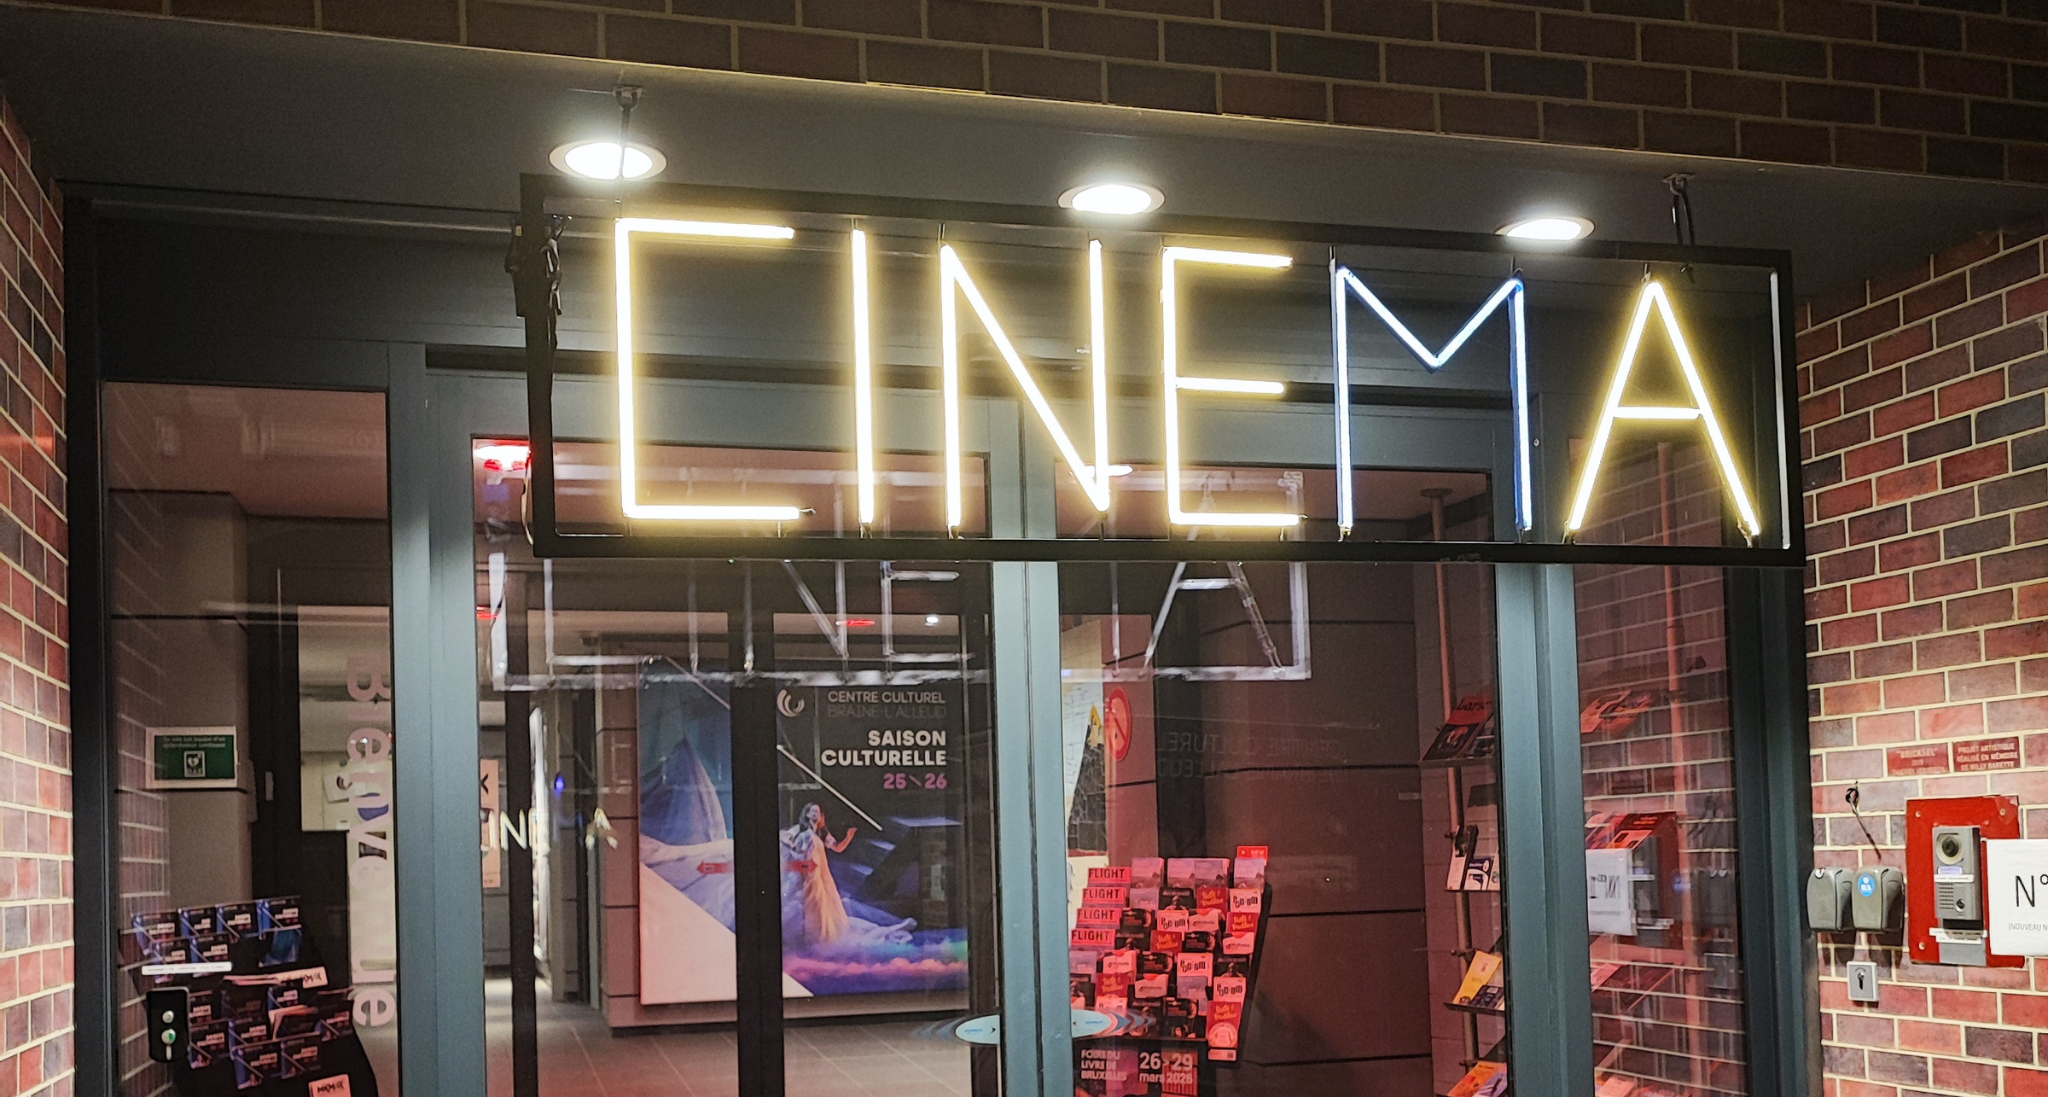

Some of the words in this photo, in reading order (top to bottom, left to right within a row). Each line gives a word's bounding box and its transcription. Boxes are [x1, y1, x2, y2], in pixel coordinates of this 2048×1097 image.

[614, 217, 1762, 543] CINEMA
[827, 690, 879, 703] CENTRE
[881, 691, 946, 704] CULTUREL
[868, 730, 947, 746] SAISON
[821, 749, 947, 766] CULTURELLE
[1088, 868, 1125, 879] FLIGHT
[1083, 888, 1120, 899] FLIGHT
[1077, 909, 1115, 920] FLIGHT
[1071, 930, 1110, 941] FLIGHT
[1081, 1049, 1107, 1059] FOIRE
[1107, 1049, 1121, 1060] DU
[1081, 1060, 1105, 1069] LIVRE
[1081, 1070, 1128, 1081] BRUXELLES
[1139, 1073, 1165, 1083] mars
